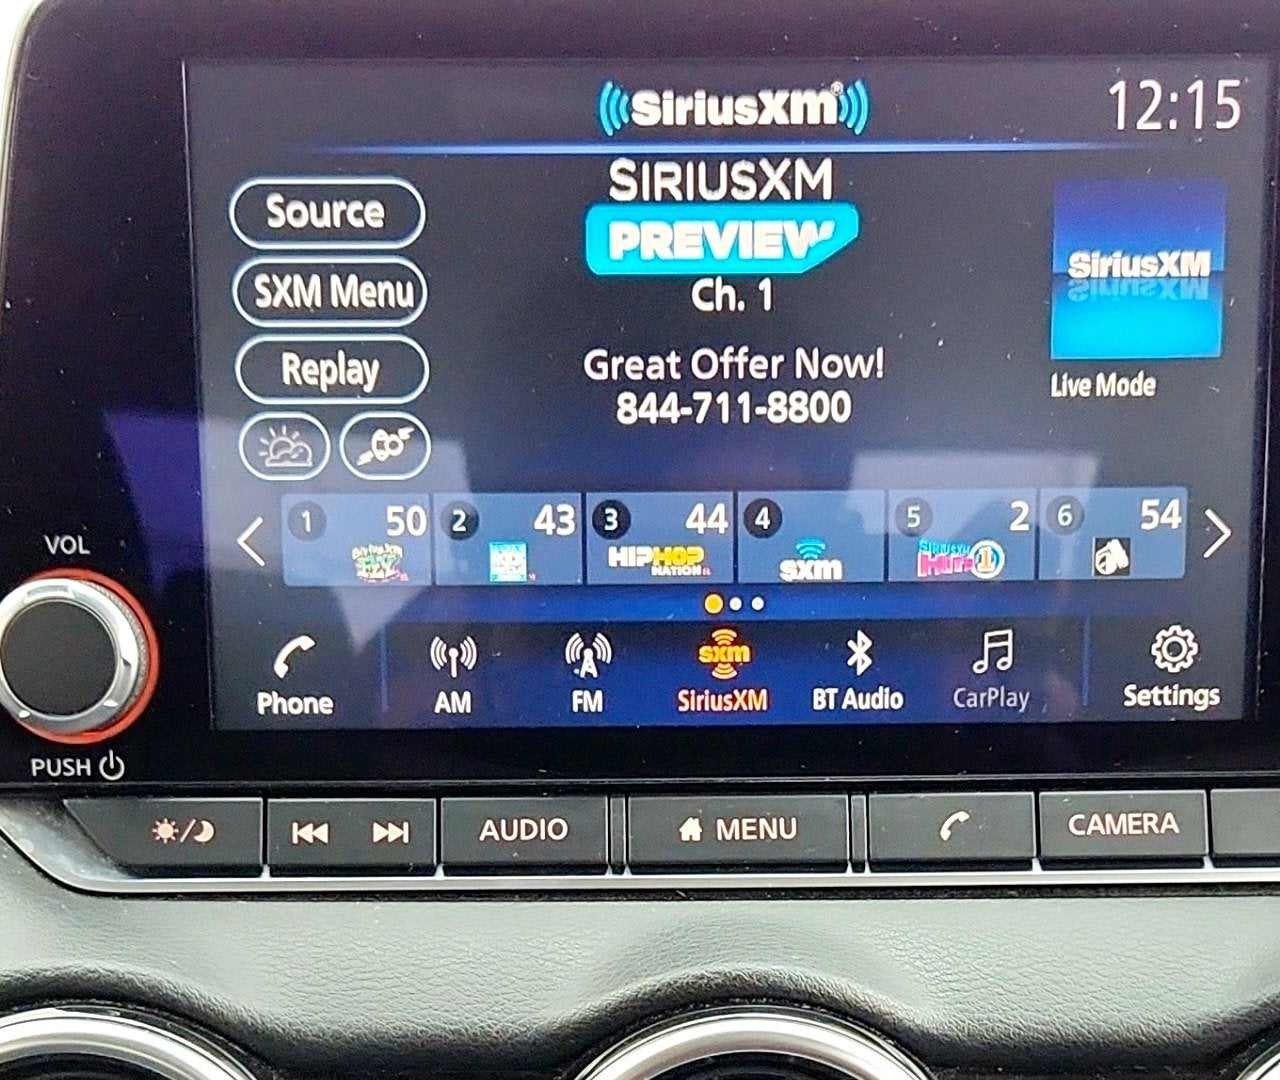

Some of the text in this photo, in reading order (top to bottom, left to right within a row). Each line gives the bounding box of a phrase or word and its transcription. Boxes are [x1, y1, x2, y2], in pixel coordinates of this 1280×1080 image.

[1108, 79, 1242, 131] 12:15
[609, 157, 833, 201] SIRIUSXM
[266, 193, 385, 229] Source
[609, 220, 836, 260] PREVIEW
[1068, 250, 1211, 279] SiriusXM
[254, 274, 415, 309] SXM Menu
[691, 275, 772, 311] Ch. 1
[282, 351, 380, 391] Replay
[583, 346, 885, 380] Great Offer Now!
[1050, 371, 1157, 396] Live Mode
[617, 390, 852, 425] 844-711-8800
[300, 510, 312, 533] 1
[386, 504, 427, 536] 50
[452, 509, 467, 532] 2
[534, 504, 575, 535] 43
[604, 507, 618, 531] 3
[685, 503, 729, 534] 44
[754, 506, 771, 530] 4
[907, 506, 921, 528] 5
[1009, 501, 1030, 531] 2
[1057, 504, 1073, 526] 6
[1140, 499, 1183, 531] 54
[45, 535, 91, 555] VOL
[651, 565, 702, 577] NATION
[779, 558, 843, 582] sxm
[257, 691, 334, 715] Phone
[434, 691, 472, 714] AM
[572, 690, 603, 713] FM
[677, 688, 768, 712] SiriusXM
[813, 686, 904, 711] BT Audio
[953, 687, 1030, 711] CarPlay
[1123, 684, 1221, 712] Settings
[31, 757, 91, 777] PUSH
[478, 817, 569, 842] AUDIO
[716, 816, 798, 841] MENU
[1068, 811, 1180, 837] CAMERA
